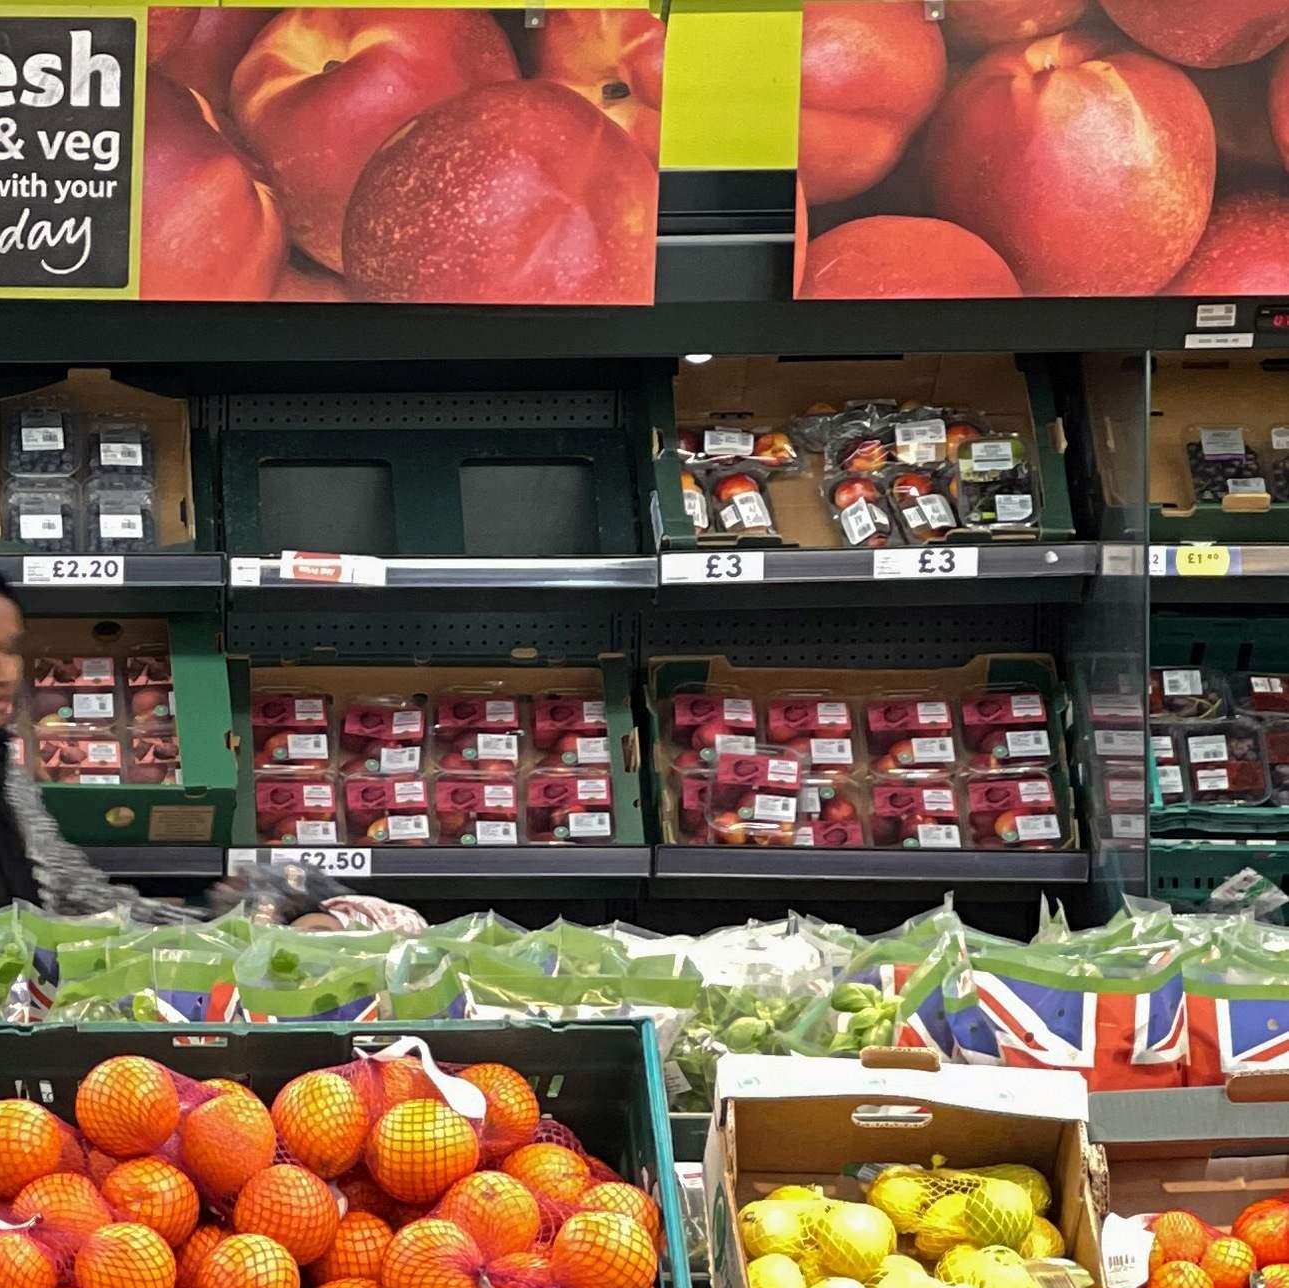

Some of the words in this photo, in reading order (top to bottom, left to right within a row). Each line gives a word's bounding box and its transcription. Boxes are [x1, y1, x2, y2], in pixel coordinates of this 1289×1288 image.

[38, 129, 120, 171] veg
[54, 181, 117, 204] your
[52, 560, 119, 578] £2.20
[705, 554, 742, 578] £3
[918, 549, 956, 574] £3
[300, 852, 366, 870] £2.50
